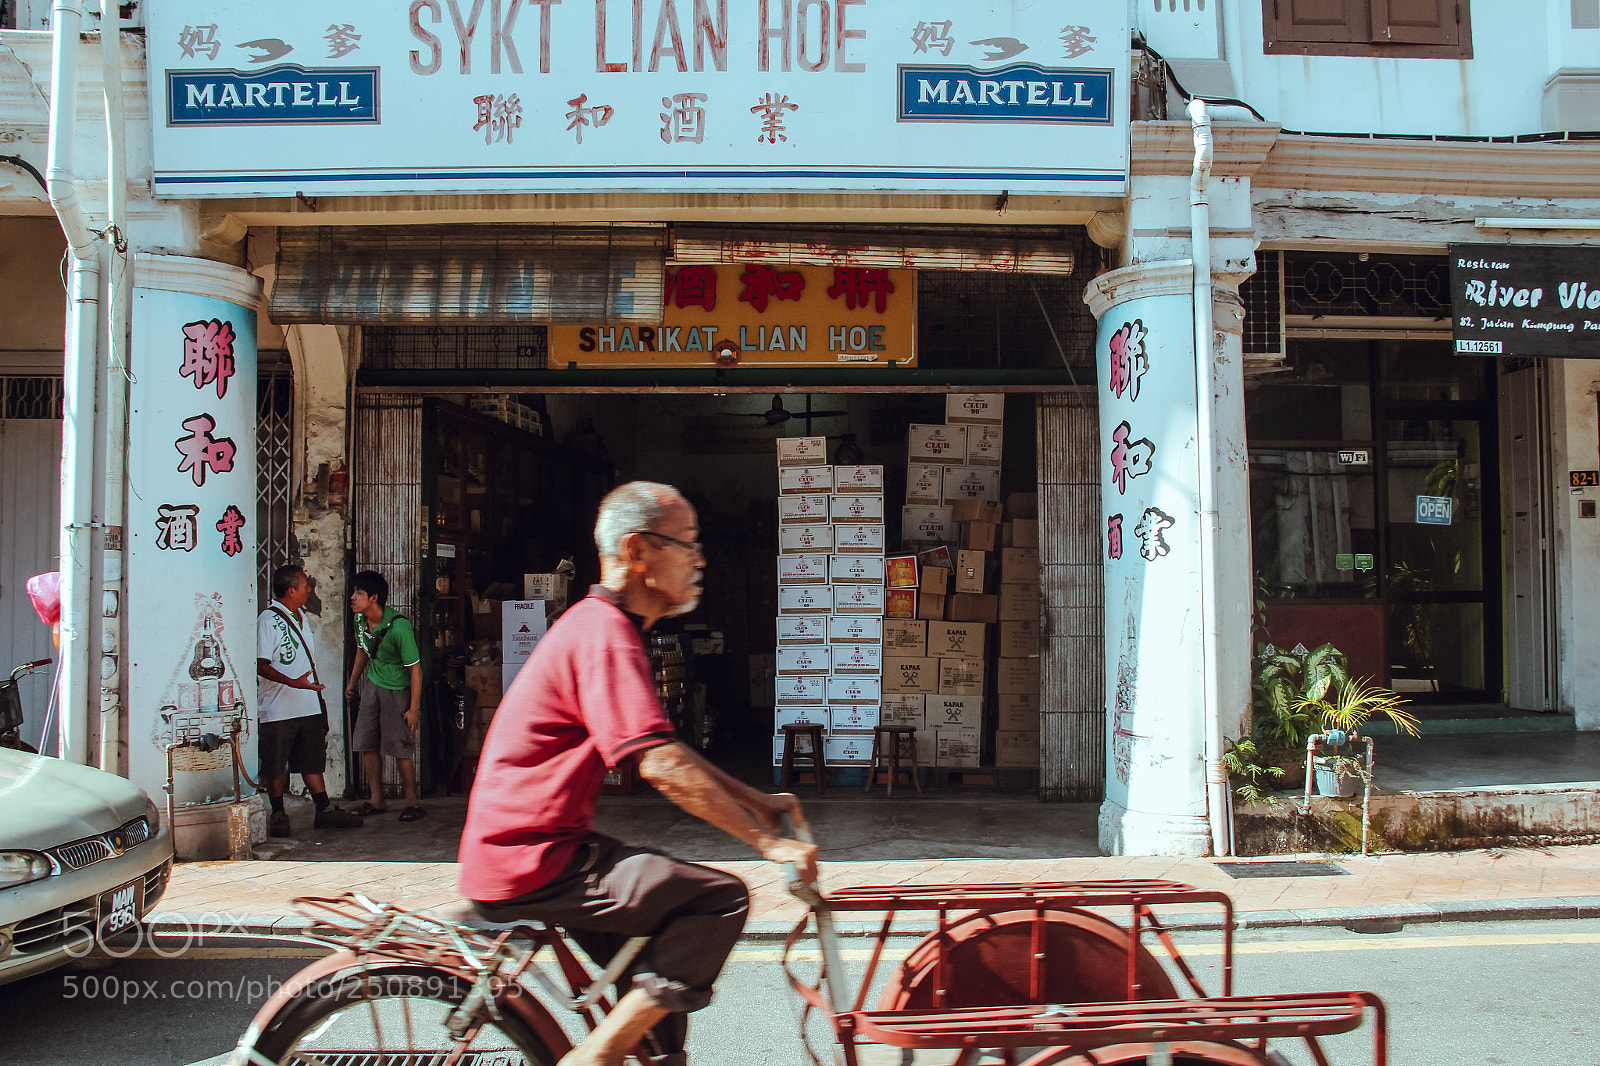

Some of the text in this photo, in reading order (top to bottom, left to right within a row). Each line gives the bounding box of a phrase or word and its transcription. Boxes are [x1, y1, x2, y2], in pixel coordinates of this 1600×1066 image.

[408, 0, 866, 75] SYKT LIAN HOE
[185, 82, 361, 108] MARTELL
[917, 79, 1094, 107] MARTELL
[1465, 280, 1543, 307] River
[1481, 318, 1515, 330] Jalan
[578, 325, 886, 353] SHARIKAT LIAN HOE
[1460, 341, 1500, 352] L1.12561
[1572, 472, 1598, 486] 82-1
[1420, 502, 1450, 518] OPEN
